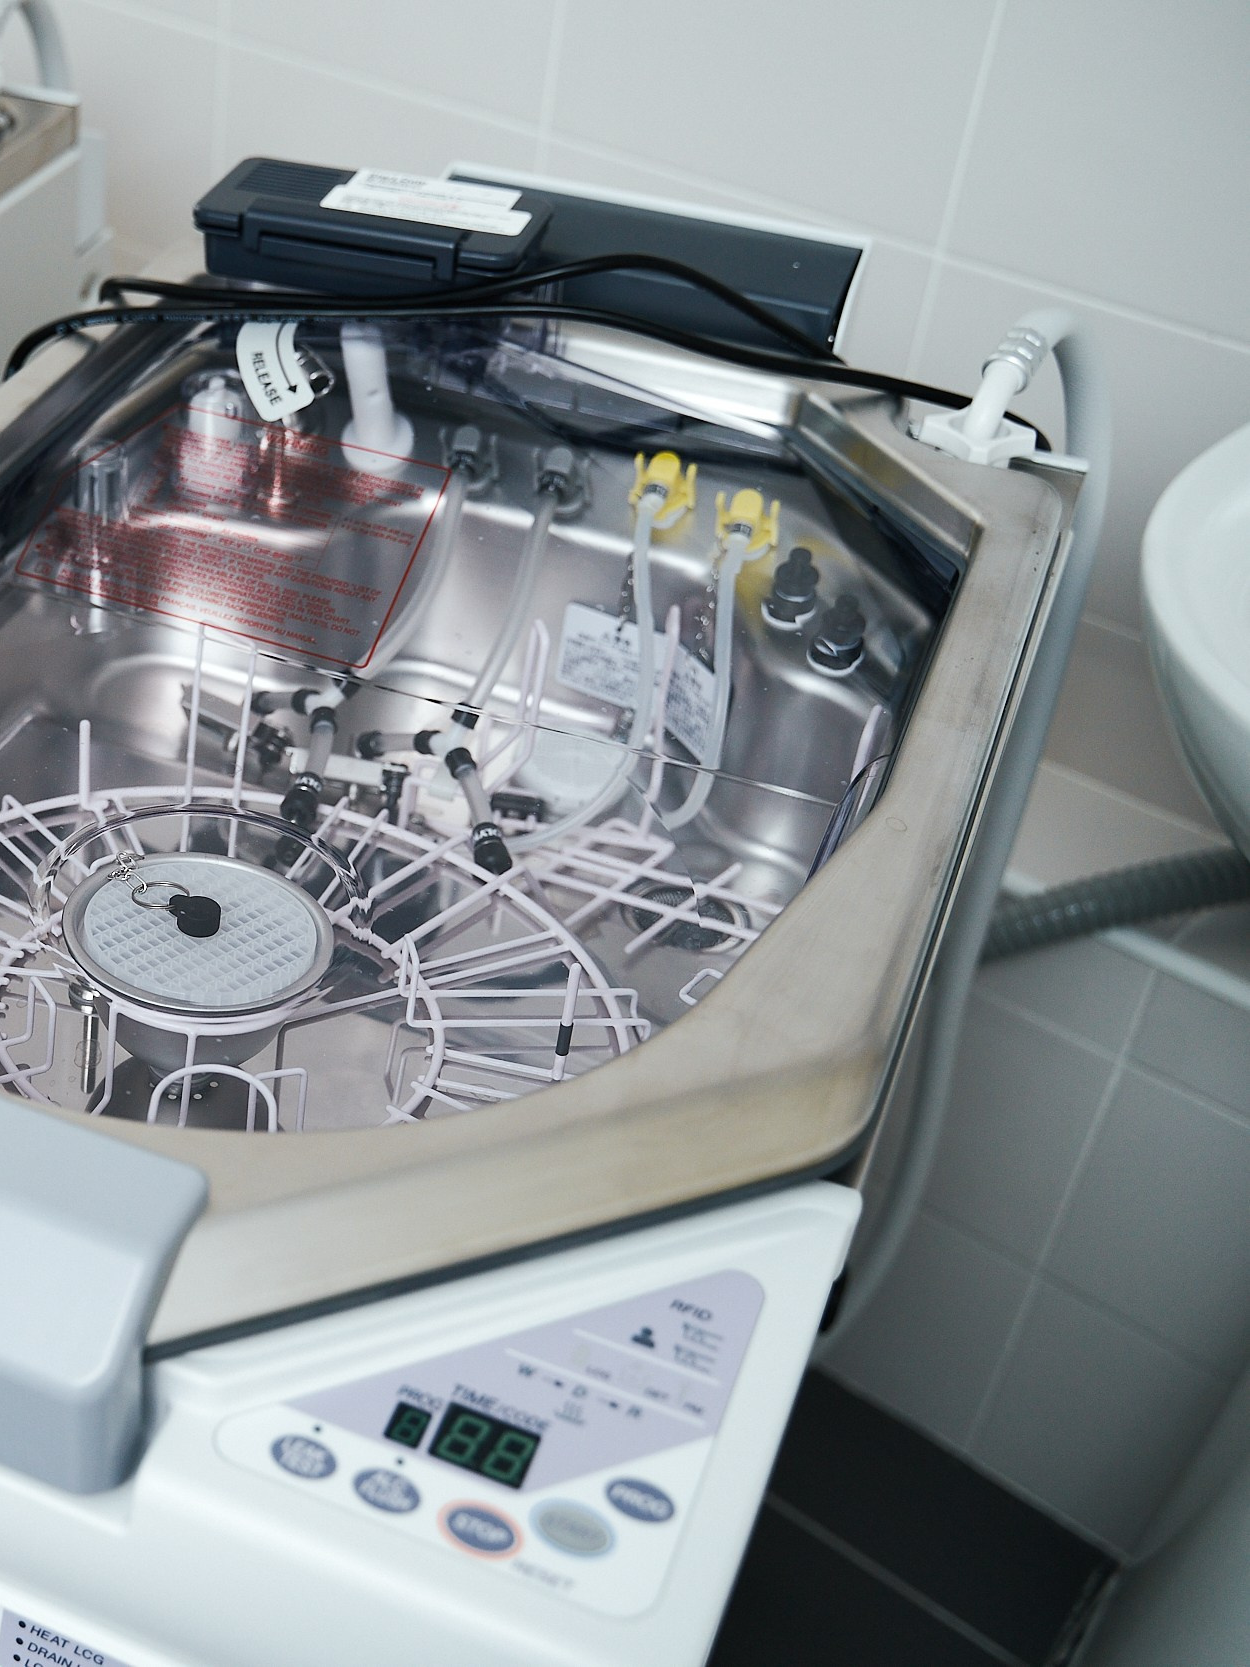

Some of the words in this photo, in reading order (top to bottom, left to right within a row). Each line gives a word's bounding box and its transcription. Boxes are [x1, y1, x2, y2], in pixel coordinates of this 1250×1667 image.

[252, 351, 283, 406] RELEASE
[670, 1298, 714, 1323] RFID
[611, 1483, 670, 1518] PROG
[452, 1511, 514, 1545] STOP
[26, 1641, 74, 1667] DRAIN
[29, 1625, 70, 1649] HEAT
[73, 1645, 105, 1666] LCG
